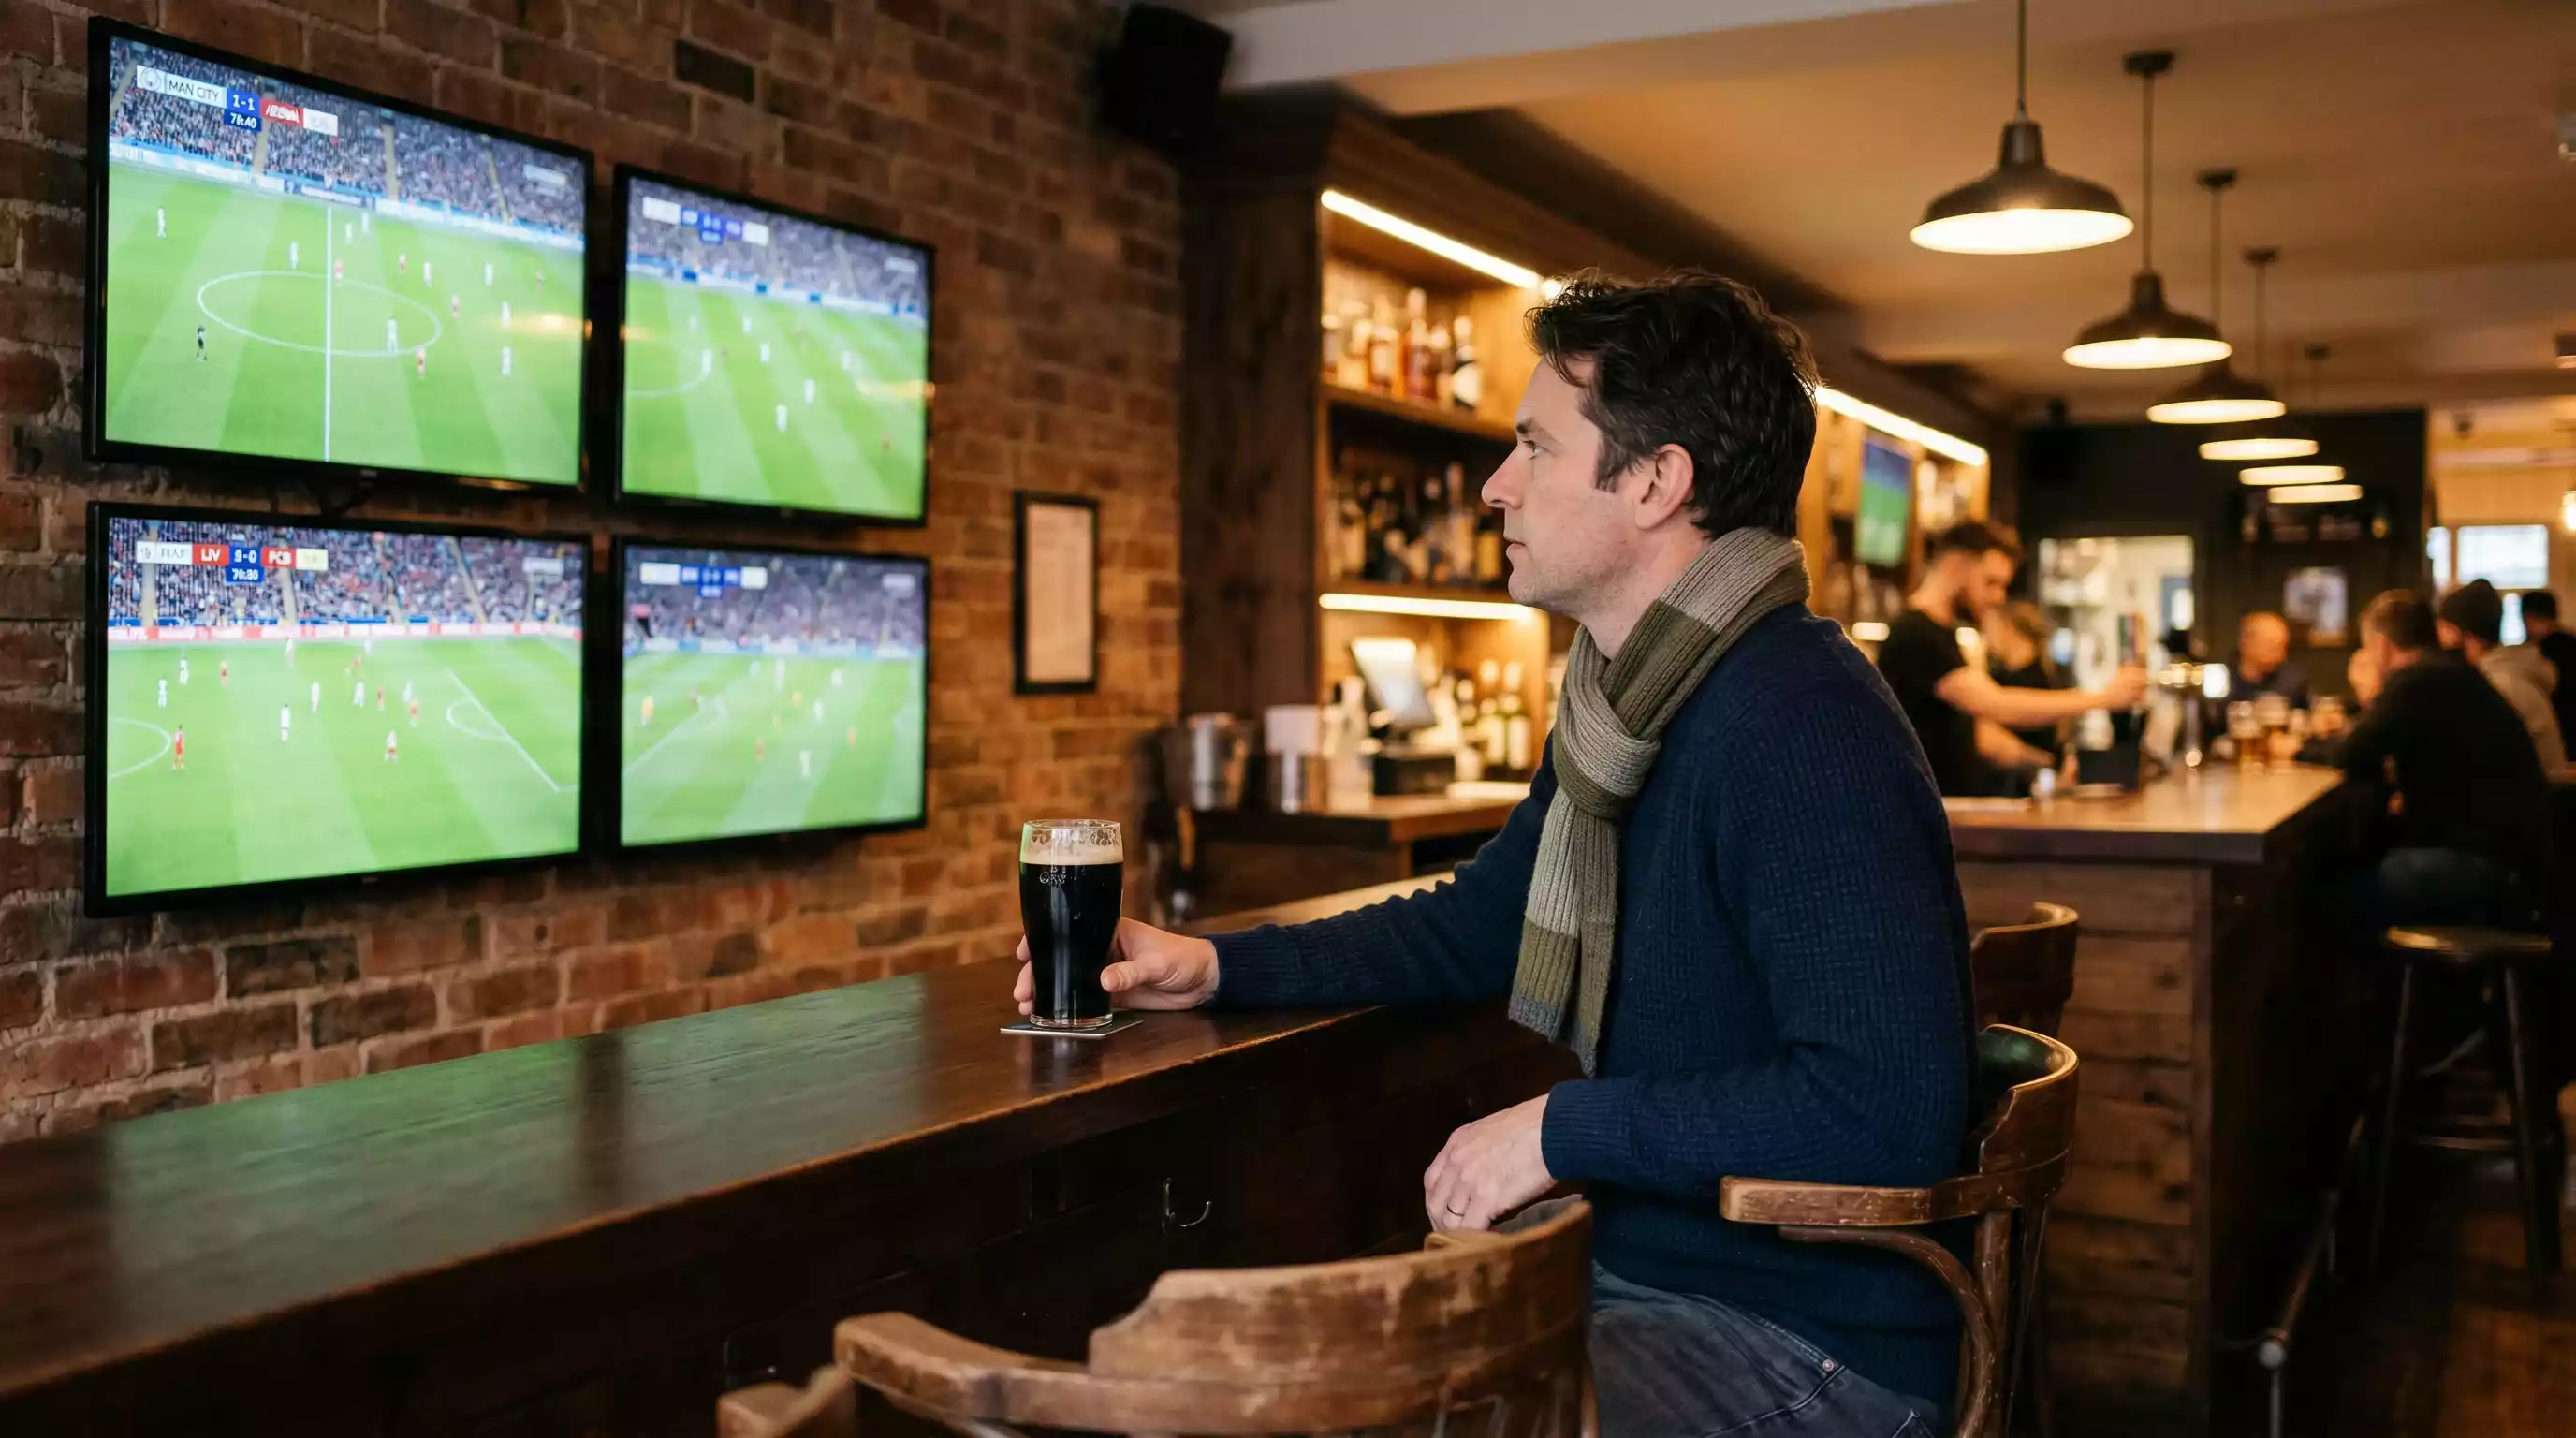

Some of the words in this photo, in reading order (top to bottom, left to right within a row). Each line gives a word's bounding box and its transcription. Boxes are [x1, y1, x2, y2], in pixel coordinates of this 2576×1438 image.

[169, 80, 194, 95] MAN
[197, 87, 220, 102] CITY
[232, 94, 256, 111] 1-1
[201, 547, 222, 562] LIV
